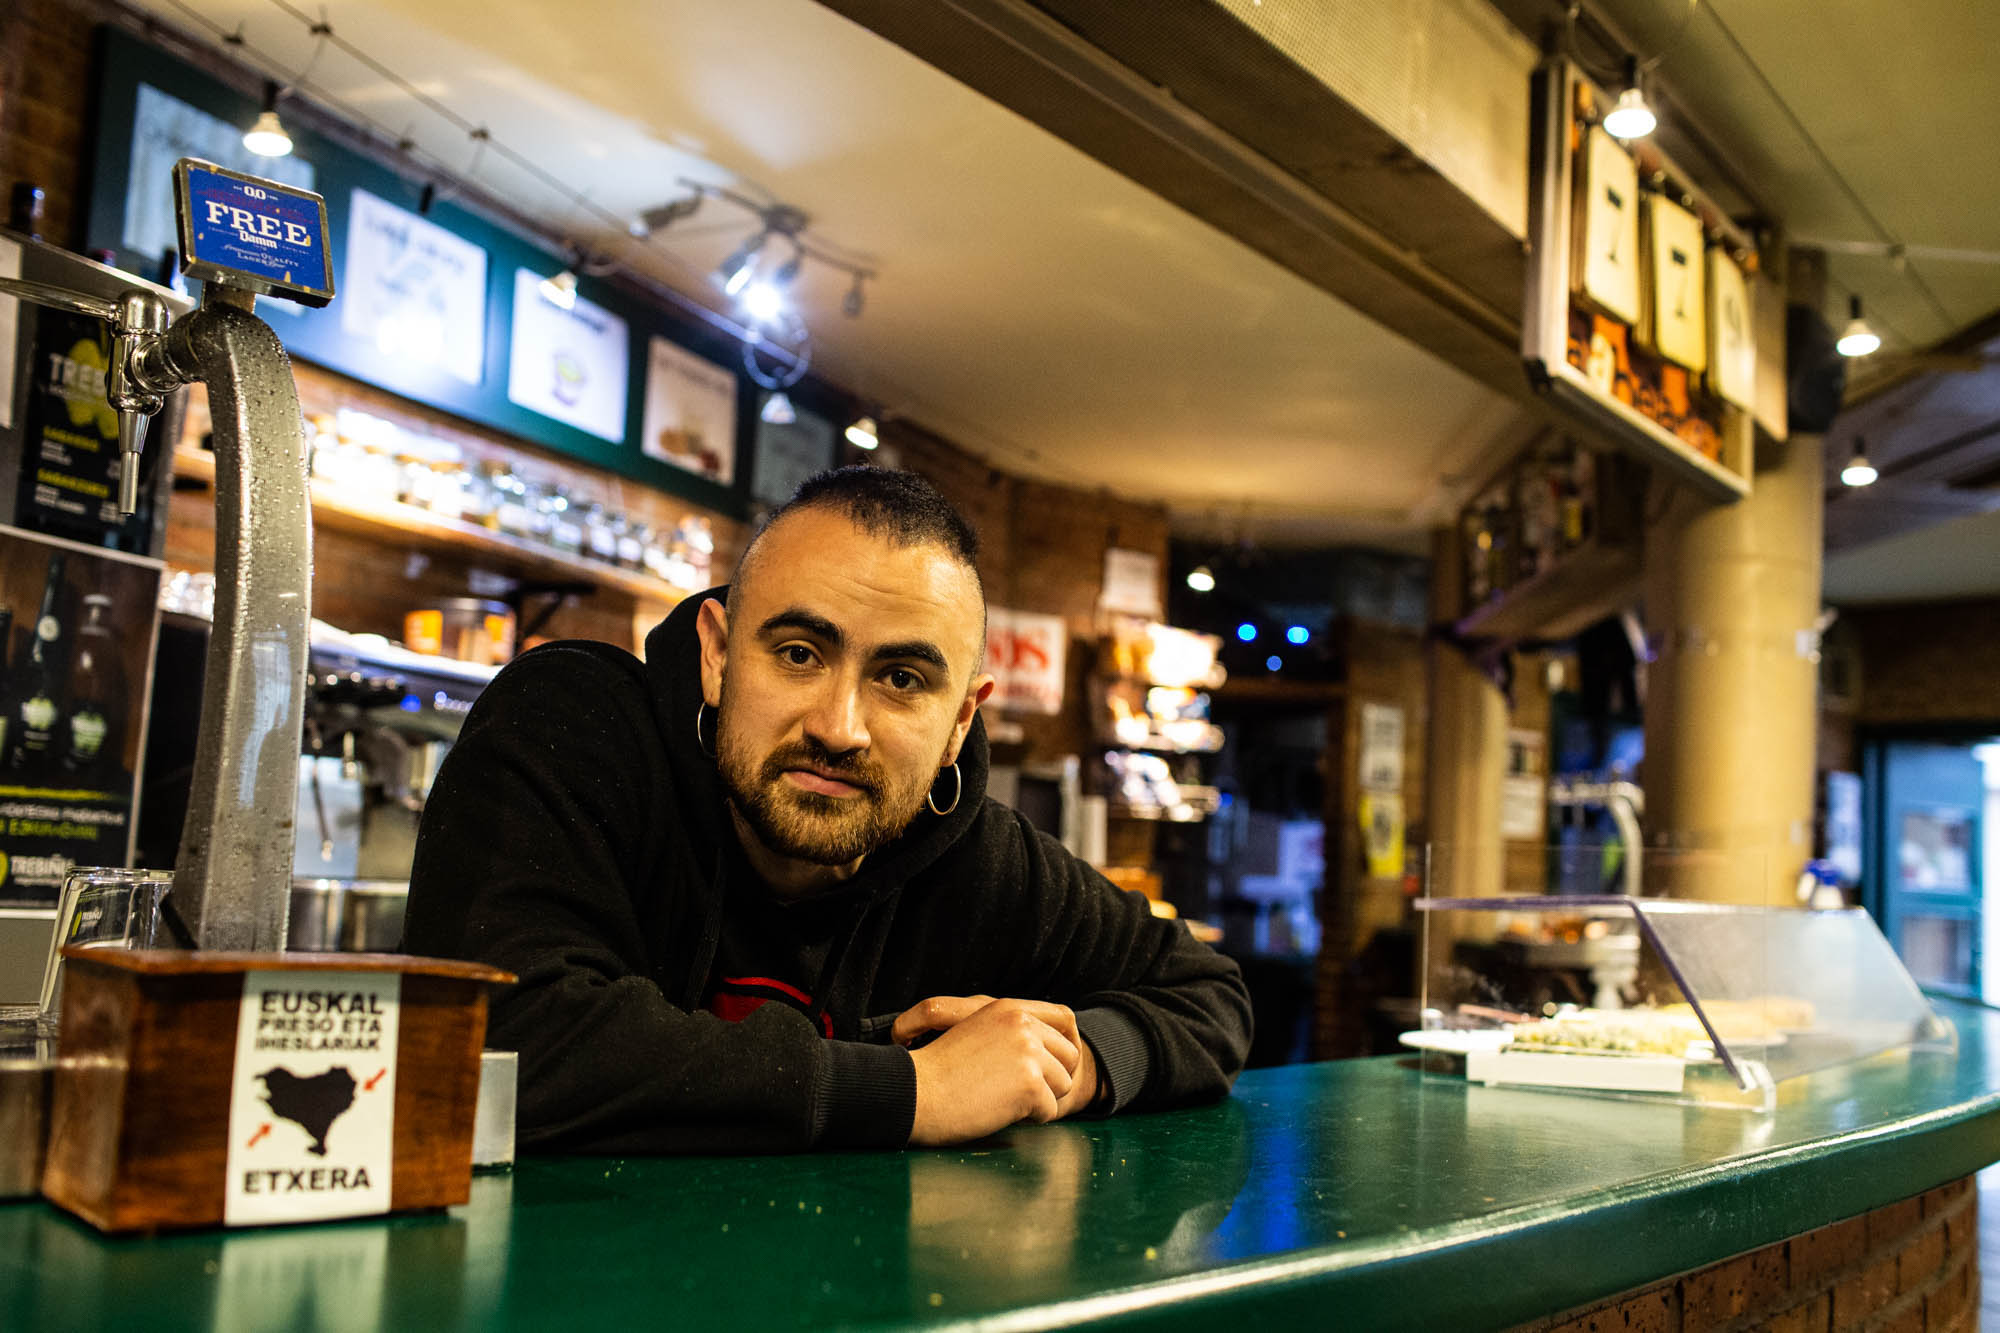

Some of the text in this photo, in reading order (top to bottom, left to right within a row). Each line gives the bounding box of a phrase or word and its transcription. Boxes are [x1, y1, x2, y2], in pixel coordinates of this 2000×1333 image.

[205, 200, 311, 247] FREE
[239, 229, 278, 249] Damm
[260, 989, 383, 1015] EUSKAL
[258, 1015, 381, 1033] PRESO ETA
[244, 1168, 371, 1193] ETXERA
